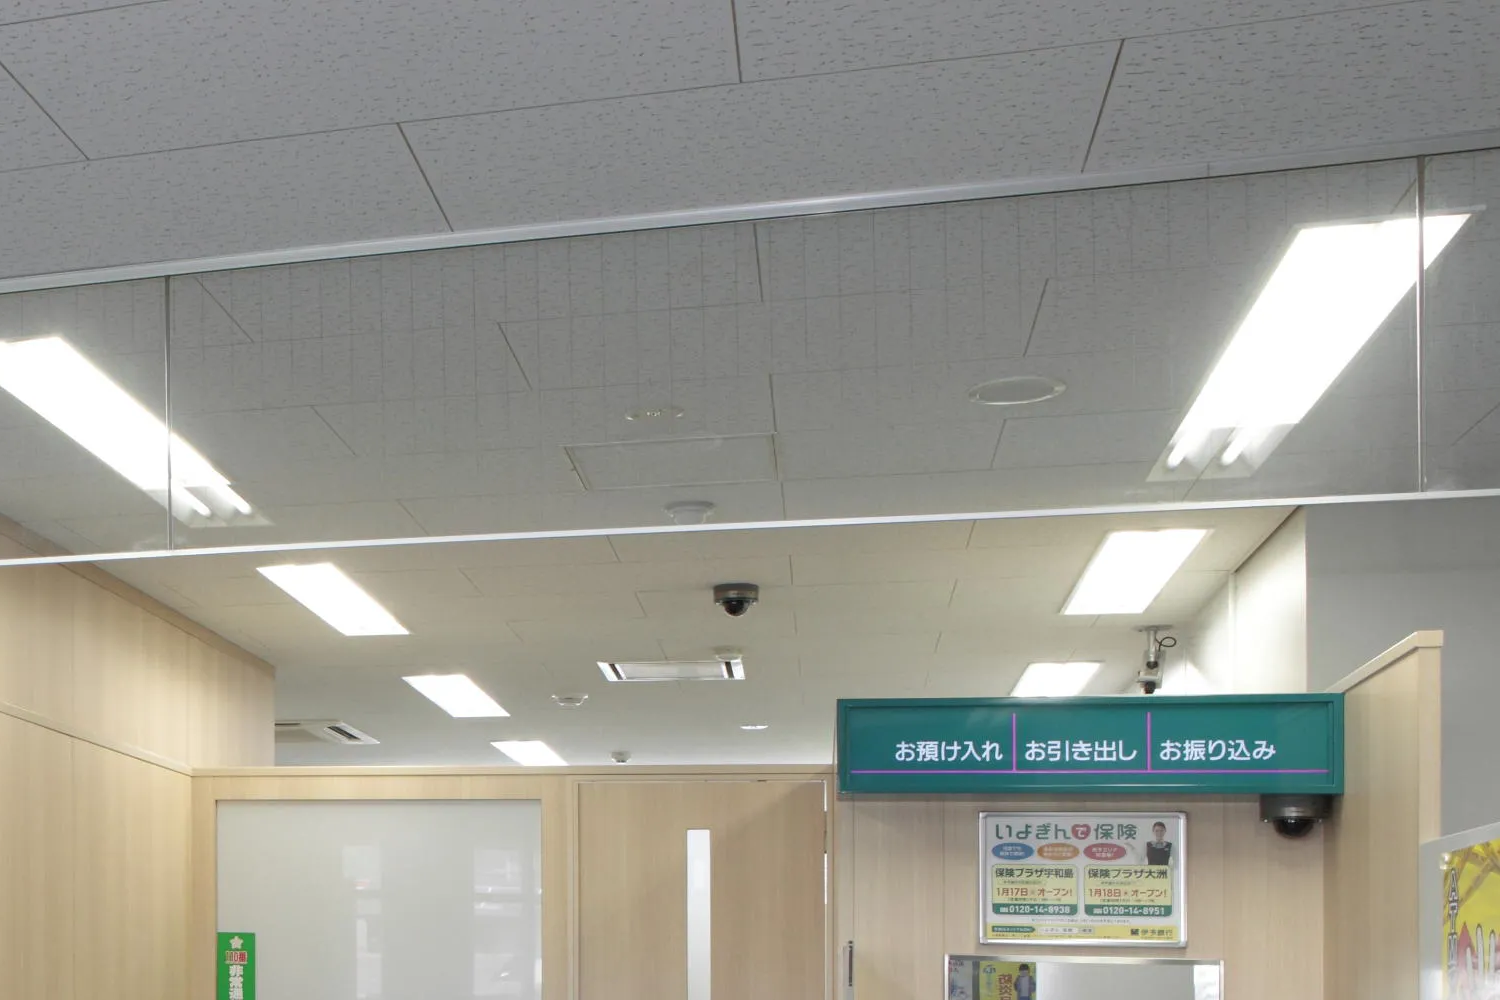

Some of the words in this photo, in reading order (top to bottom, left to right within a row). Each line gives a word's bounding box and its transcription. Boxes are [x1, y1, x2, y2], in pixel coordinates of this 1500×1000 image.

[895, 740, 1003, 761] お預け入れ
[1025, 739, 1137, 761] お引き出し
[1159, 739, 1276, 761] お振り込み
[995, 823, 1137, 841] いよぎんで保険
[995, 868, 1073, 878] 保険プラザ宇和島
[1088, 869, 1167, 879] 保険プラザ大洲
[1103, 907, 1165, 915] 0120-14-8951
